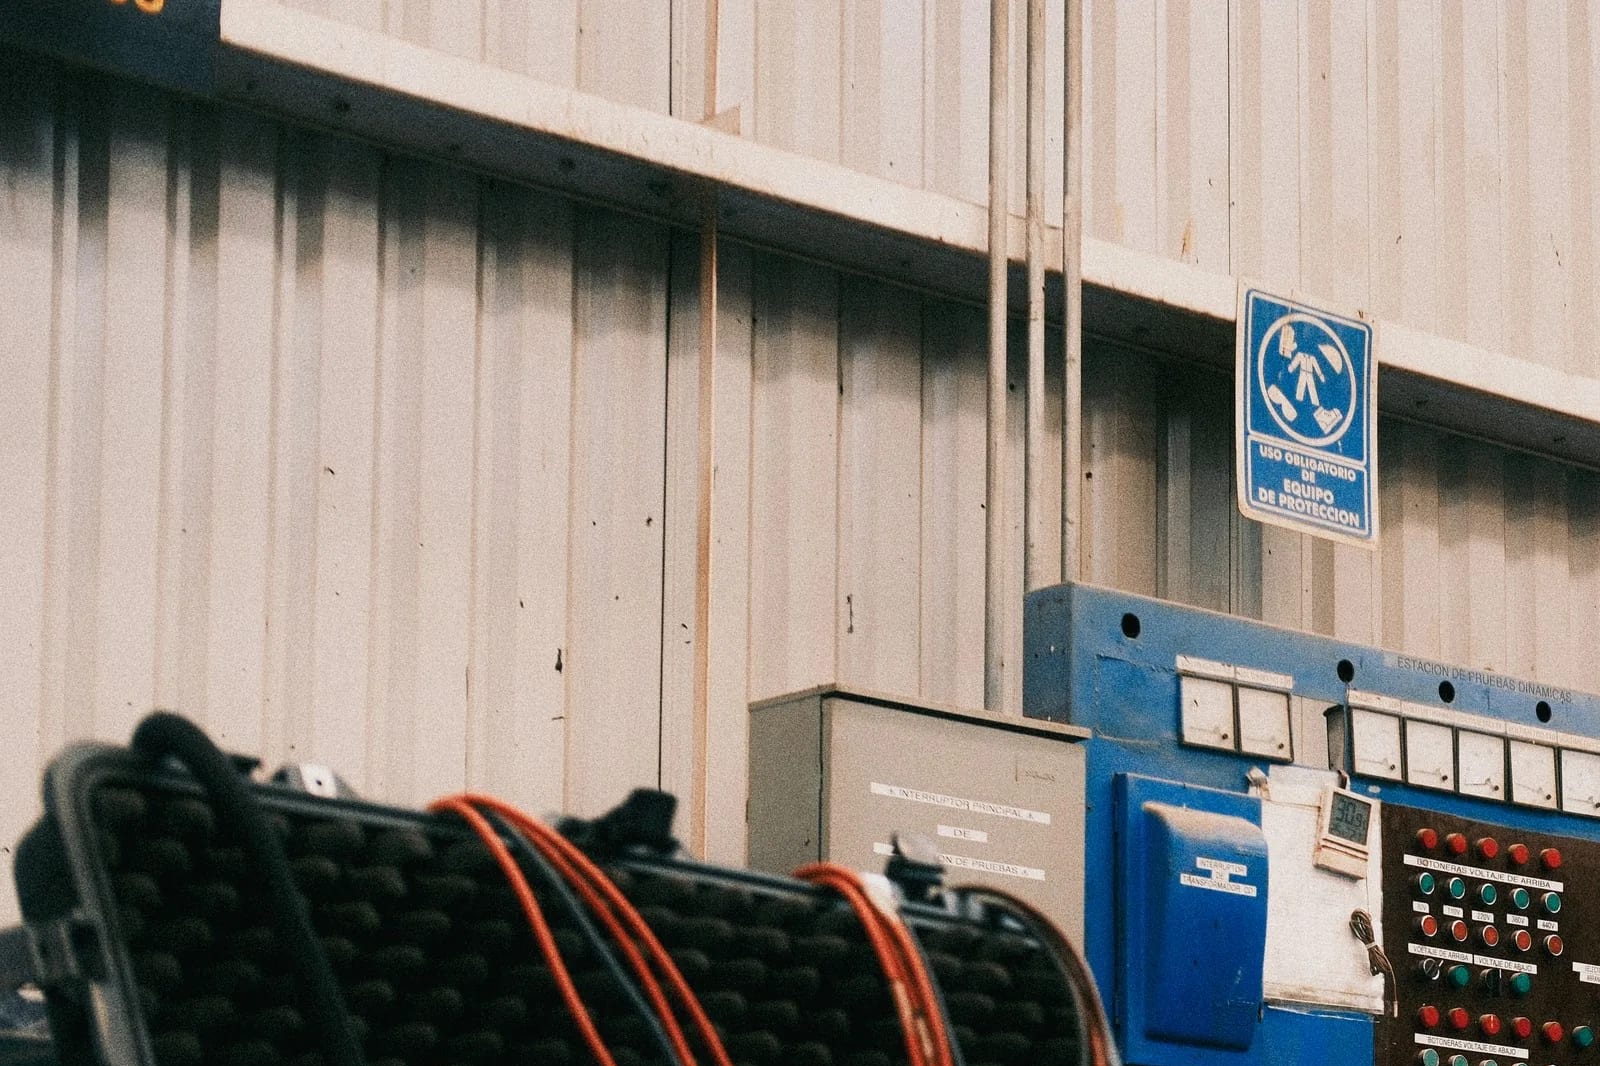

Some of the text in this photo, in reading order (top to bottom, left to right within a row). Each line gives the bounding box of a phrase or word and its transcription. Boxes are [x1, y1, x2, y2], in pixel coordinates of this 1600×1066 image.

[1260, 444, 1356, 482] USO OBLIGATORIO
[1301, 469, 1316, 483] DE
[1283, 478, 1334, 504] EQUIPO
[1258, 487, 1360, 527] DE PROTECCION
[1397, 655, 1572, 704] ESTACION DE PRUEBAS DINAMICAS
[899, 788, 1024, 818] INTERRUPTOR PRINCIPAL
[953, 828, 973, 838] DE
[955, 856, 969, 866] DE
[971, 859, 1019, 875] PRUEBAS
[1199, 858, 1246, 873] INTERRUPTOR
[1416, 857, 1551, 889] BOTONERAS VOLTAJE DE ARRIBA
[1182, 874, 1241, 892] TRANSFORMADOR
[1413, 946, 1469, 961] VOLTAJE DE ARRIBA
[1479, 956, 1533, 972] VOLTAJE DE ABAJO
[1427, 1036, 1517, 1056] BOTONERAS VOLTAJE DE ABAJO
